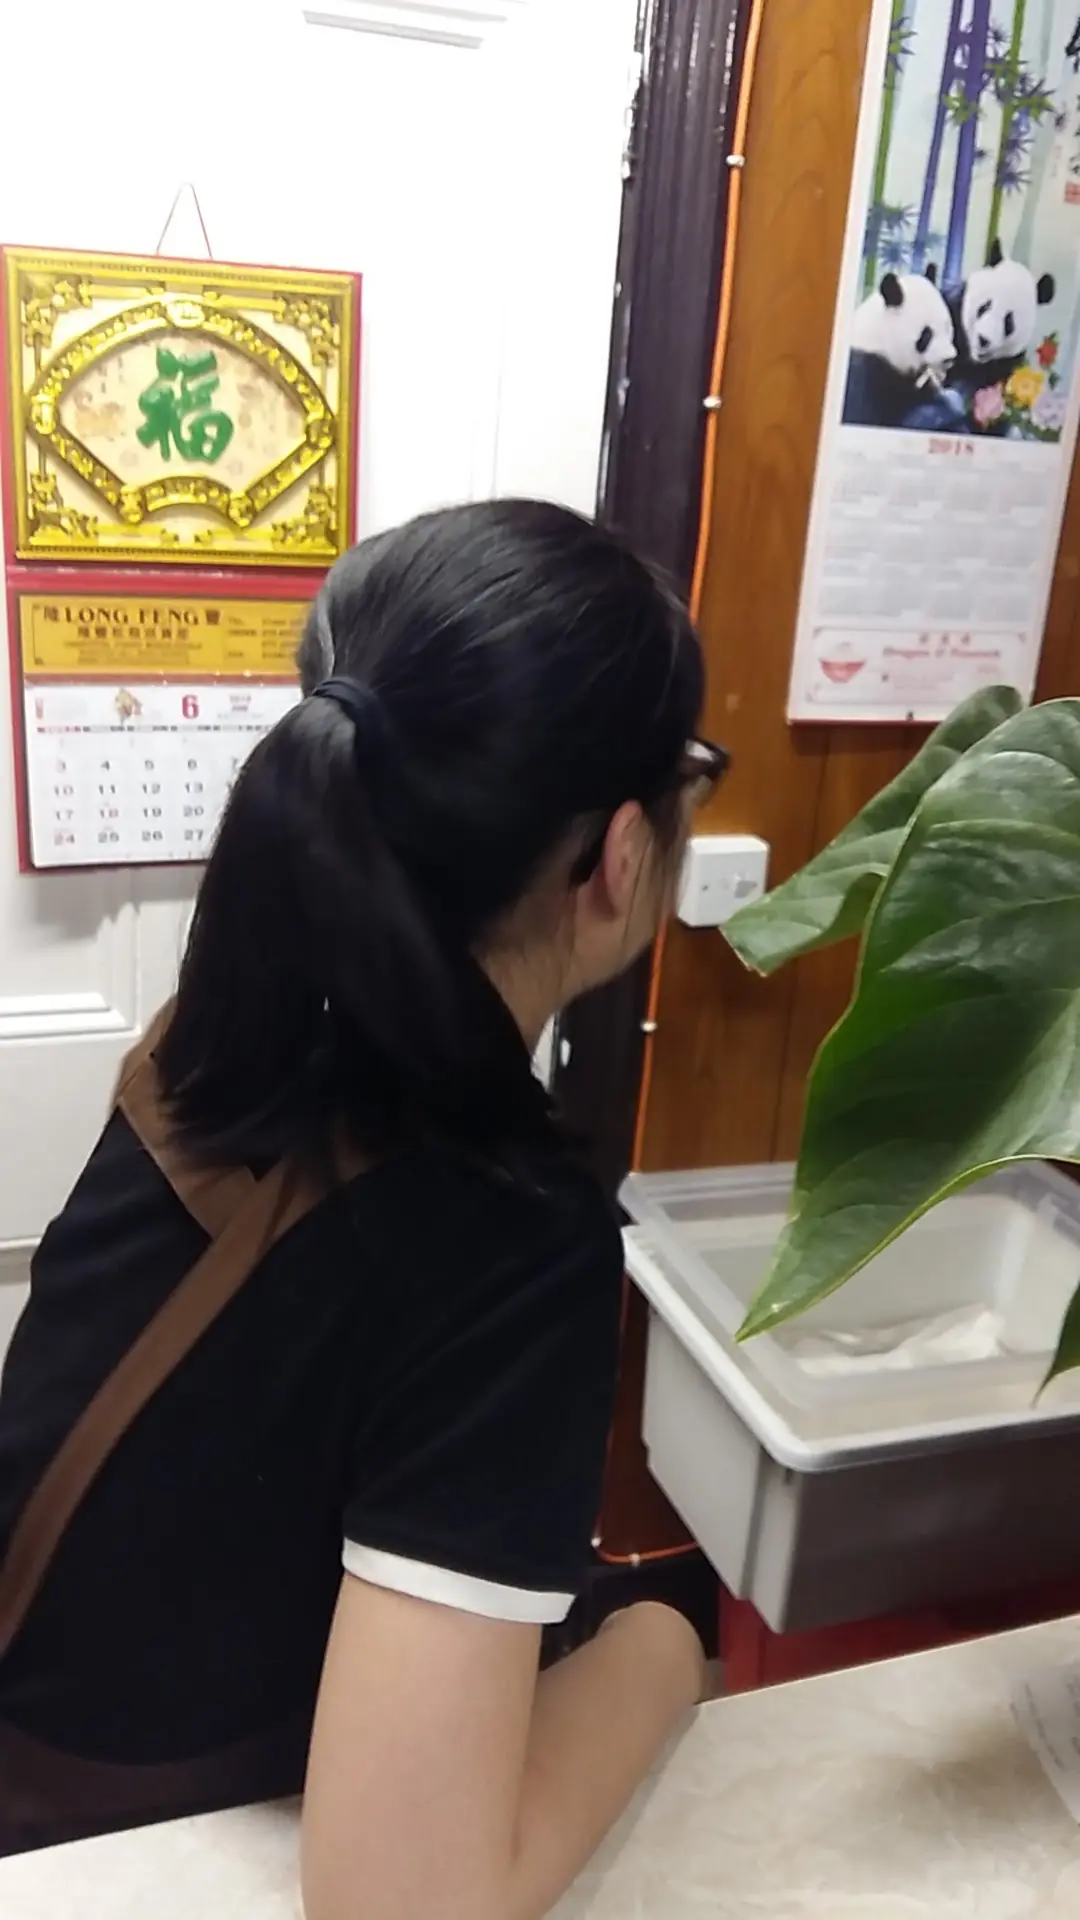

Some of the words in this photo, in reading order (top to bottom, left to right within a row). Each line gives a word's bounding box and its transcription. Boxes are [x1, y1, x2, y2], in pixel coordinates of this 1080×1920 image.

[136, 346, 235, 466] 福
[64, 606, 129, 625] LONG
[138, 608, 199, 626] FENG
[182, 694, 199, 719] 6
[57, 759, 67, 771] 3
[101, 759, 111, 771] 4
[144, 759, 155, 771] 5
[187, 758, 198, 771] 6
[54, 784, 74, 797] 10
[98, 783, 117, 795] 11
[142, 782, 161, 795] 12
[185, 781, 204, 794] 13
[56, 809, 74, 821] 17
[99, 807, 119, 819] 18
[143, 807, 162, 819] 19
[183, 805, 204, 818] 20
[54, 832, 76, 846] 24
[98, 831, 120, 844] 25
[141, 830, 163, 843] 26
[184, 829, 204, 842] 27
